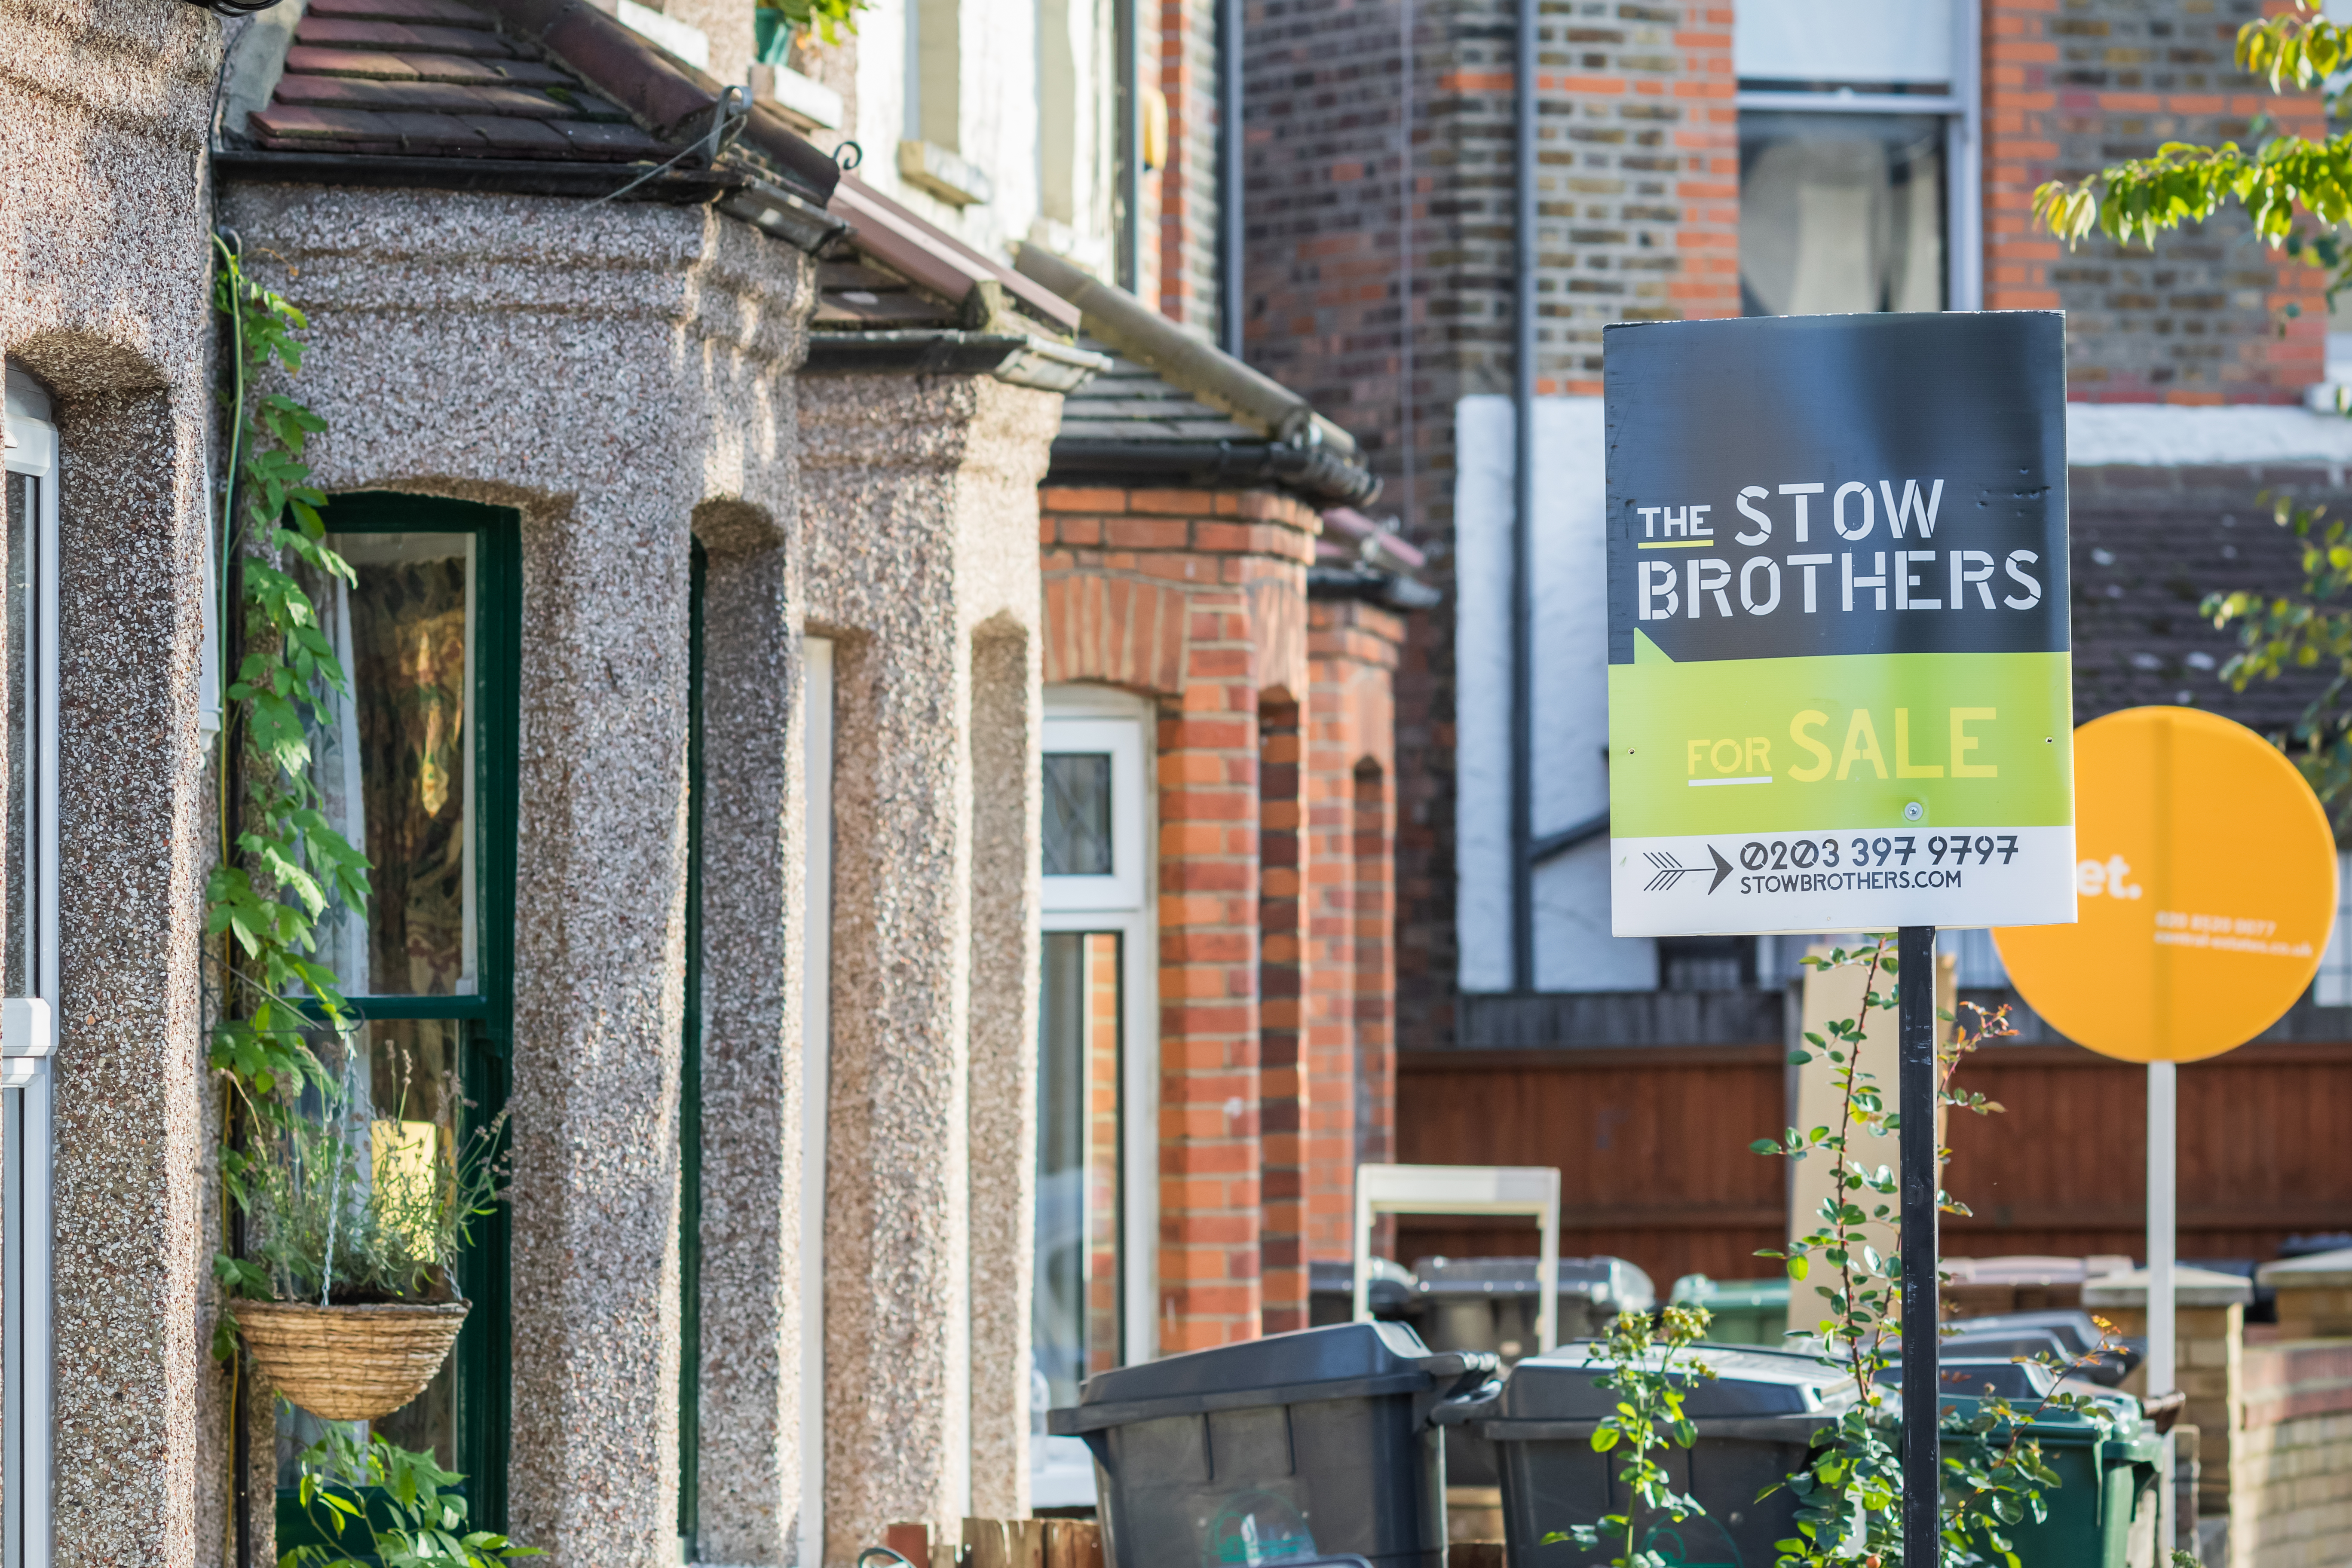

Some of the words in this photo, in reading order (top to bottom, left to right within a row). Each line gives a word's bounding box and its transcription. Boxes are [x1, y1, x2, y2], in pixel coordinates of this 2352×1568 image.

[1637, 505, 1714, 537] THE
[1734, 479, 1944, 546] STOW
[1638, 549, 2041, 620] BROTHERS
[1687, 737, 1771, 775] FOR
[1788, 707, 1998, 782] SALE
[1740, 839, 1840, 871] 0203
[1851, 836, 1917, 867] 397
[1928, 835, 2019, 865] 9797
[2077, 854, 2142, 900] et.
[1740, 870, 1961, 894] STOWBROTHERS.COM
